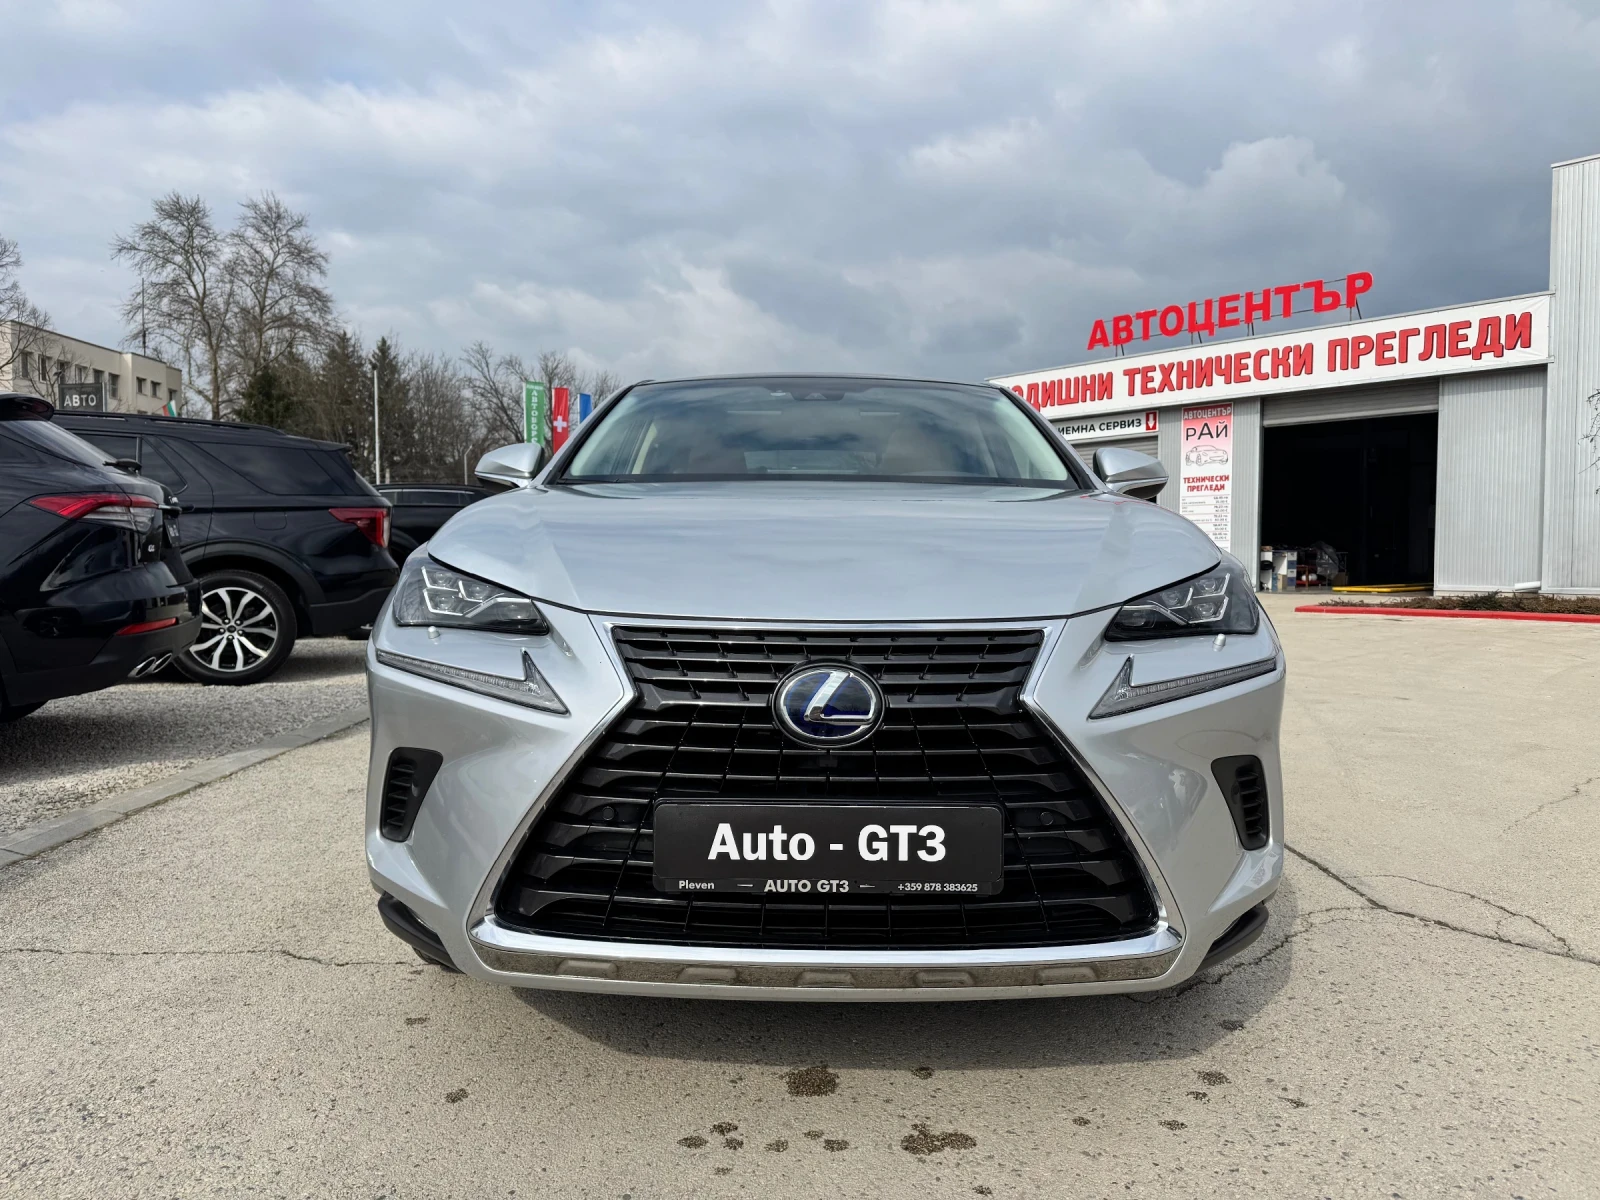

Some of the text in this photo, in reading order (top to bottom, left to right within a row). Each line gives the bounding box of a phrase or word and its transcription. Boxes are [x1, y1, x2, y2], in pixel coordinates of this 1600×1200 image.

[1087, 271, 1374, 350] АВТОЦЕНТЪР
[1011, 311, 1532, 413] ДИШНИ ТЕХНИЧЕСКИ ПРЕГЛЕДИ
[63, 394, 97, 407] АВТО
[1183, 406, 1232, 420] АВТОЦЕНТЪР
[1056, 418, 1142, 436] ИЕМНА СЕРВИЗ
[1183, 475, 1230, 484] ТЕХНИЧЕСКИ
[1186, 483, 1226, 493] ПРЕГЛЕДИ
[707, 823, 816, 861] Auto
[857, 824, 947, 862] GT3
[678, 879, 715, 890] Pleven
[763, 879, 850, 893] AUTO GT3
[897, 882, 979, 892] +359 878 383625
